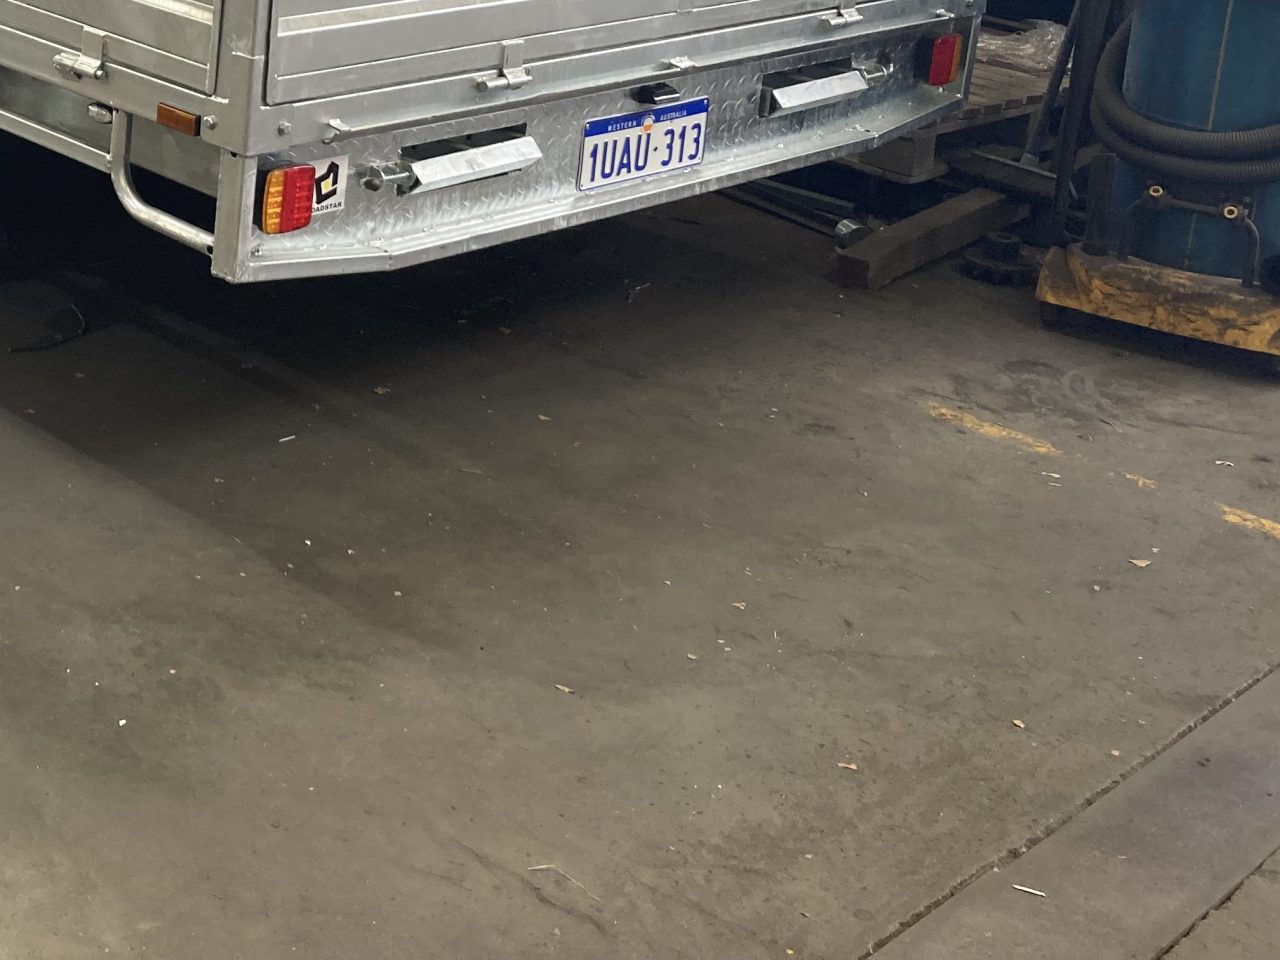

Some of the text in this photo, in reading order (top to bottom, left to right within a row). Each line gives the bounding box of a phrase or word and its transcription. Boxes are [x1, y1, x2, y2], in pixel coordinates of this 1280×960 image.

[608, 110, 687, 132] WESTERN AUSTRALIA
[312, 202, 342, 213] OADSTAR
